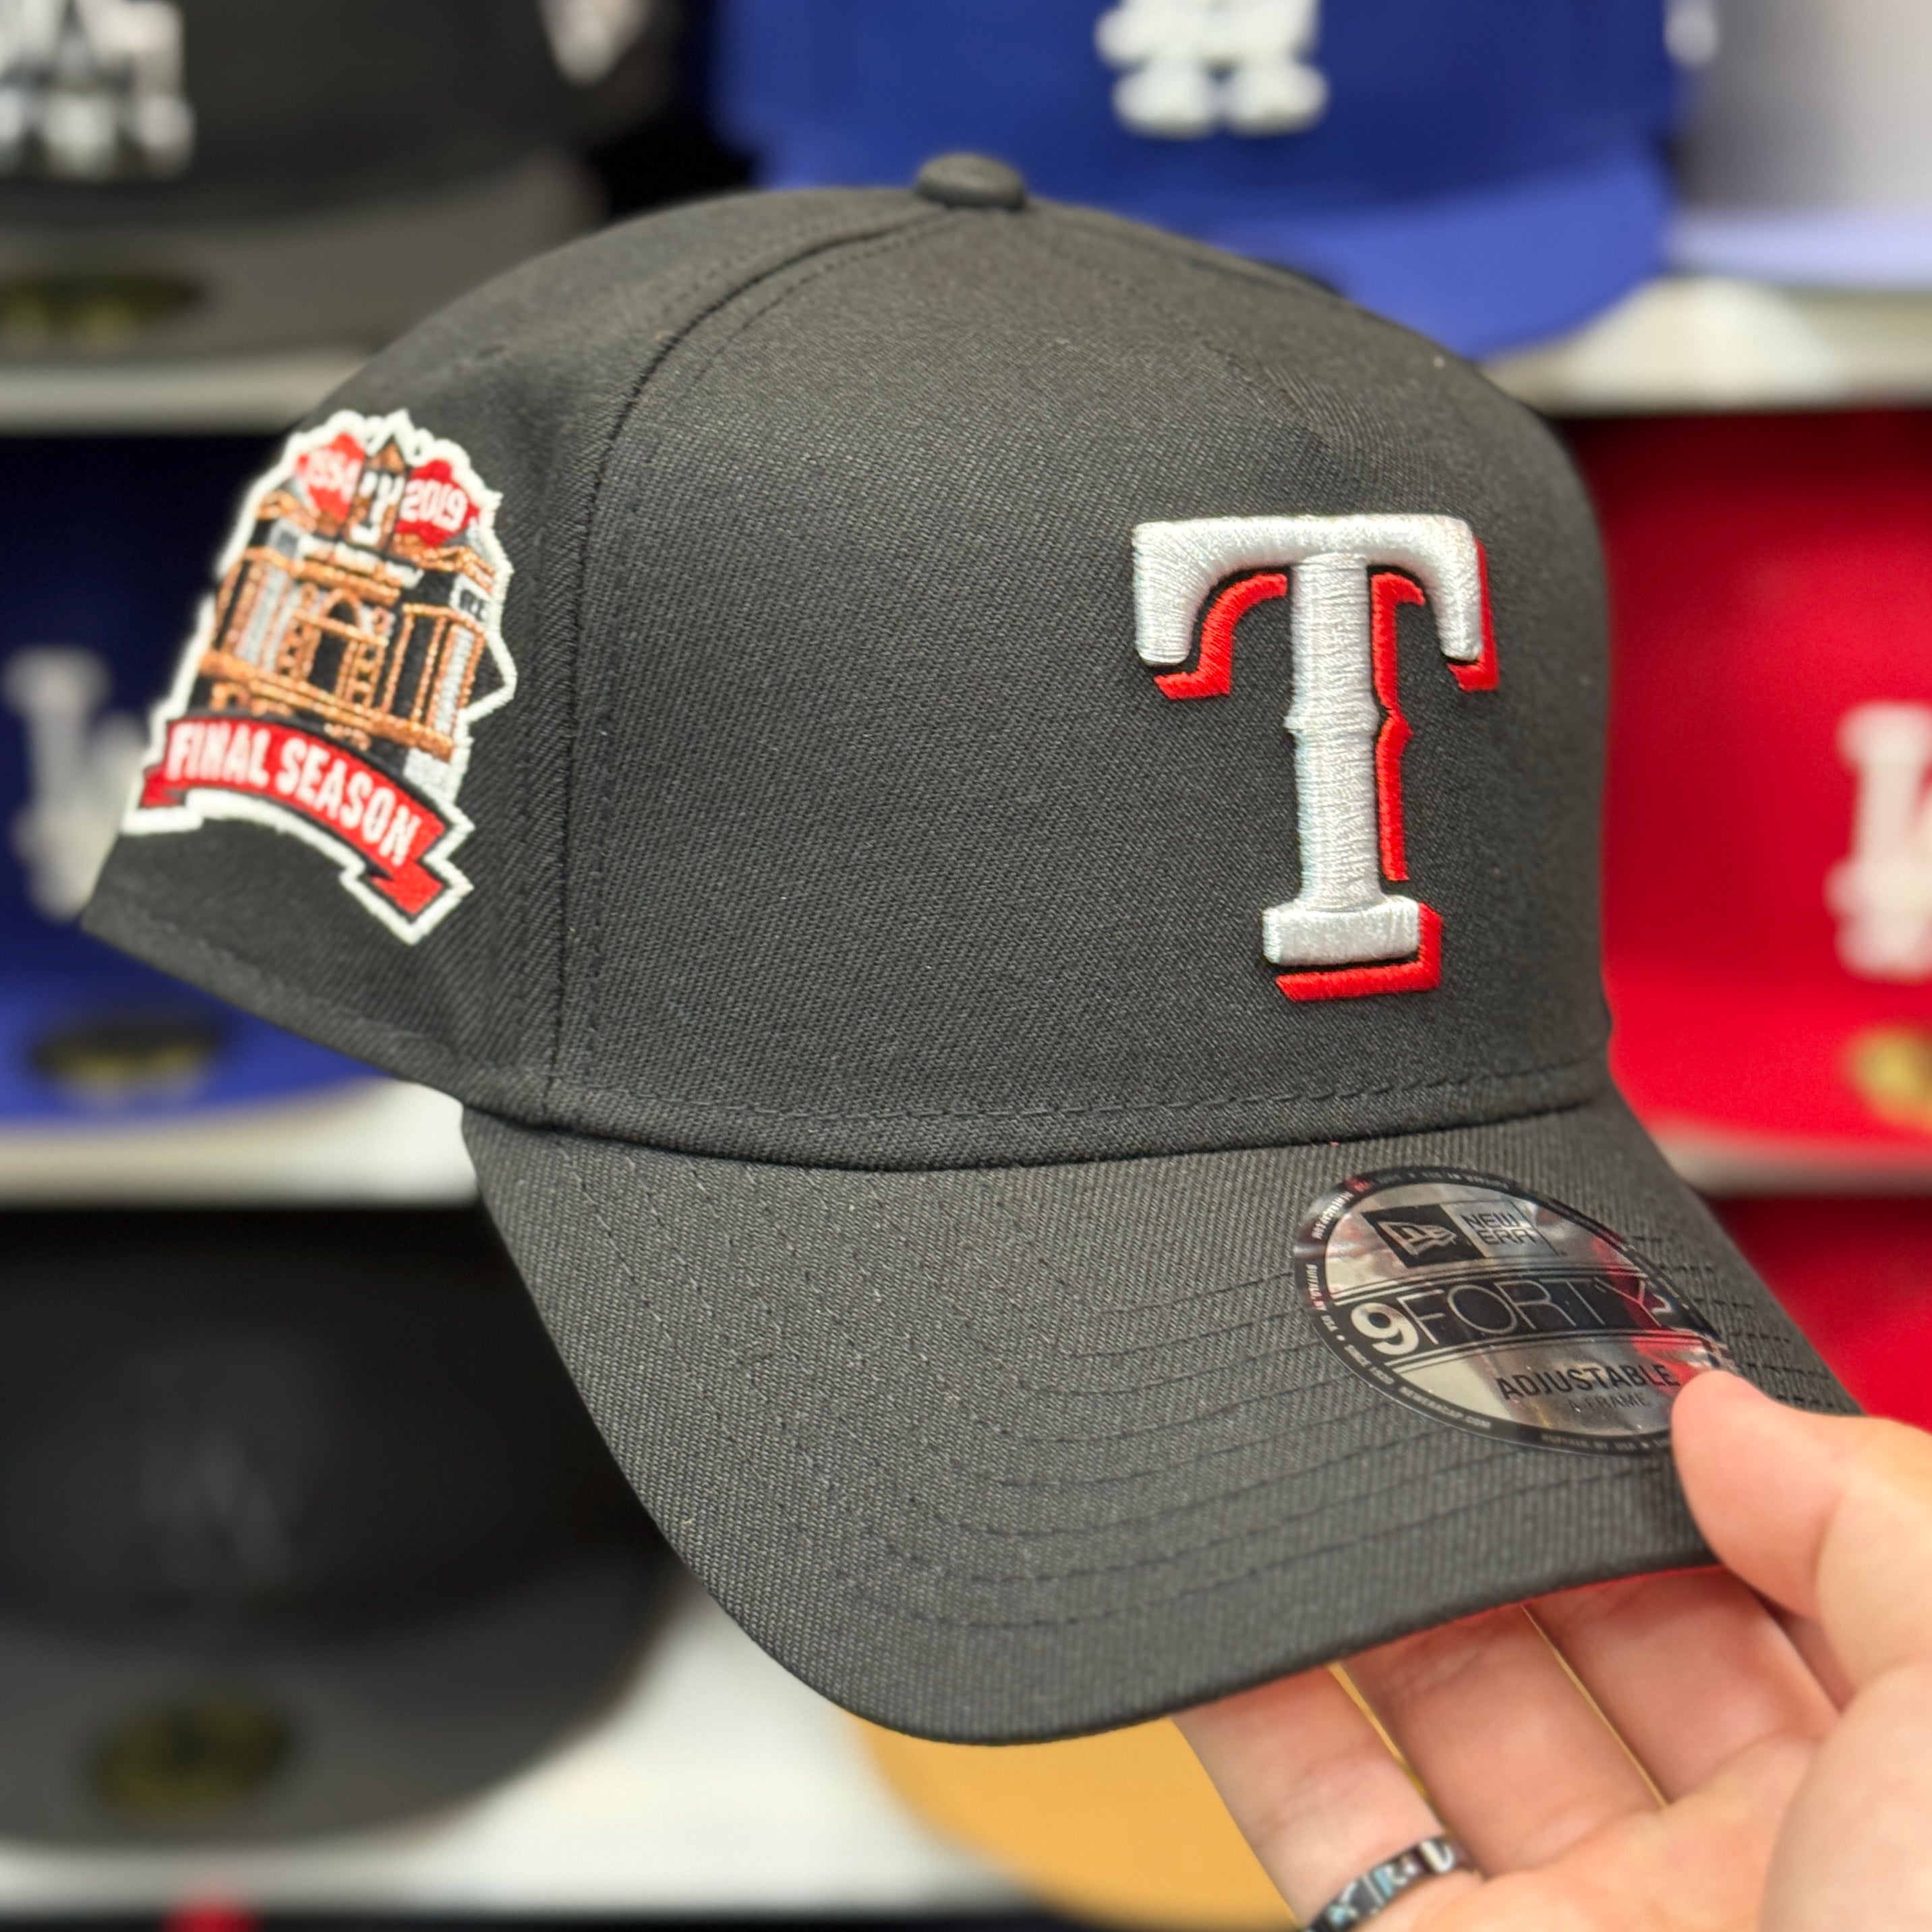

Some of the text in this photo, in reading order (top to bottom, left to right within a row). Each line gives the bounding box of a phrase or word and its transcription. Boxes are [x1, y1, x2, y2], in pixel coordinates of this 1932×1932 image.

[399, 477, 470, 533] 2019
[1132, 514, 1500, 1002] T
[165, 720, 421, 867] FINAL SEASON
[1462, 1212, 1520, 1229] NEW
[1477, 1229, 1537, 1245] ERA
[1348, 1277, 1663, 1355] 9FORTY
[1496, 1364, 1680, 1401] ADJUSTABLE
